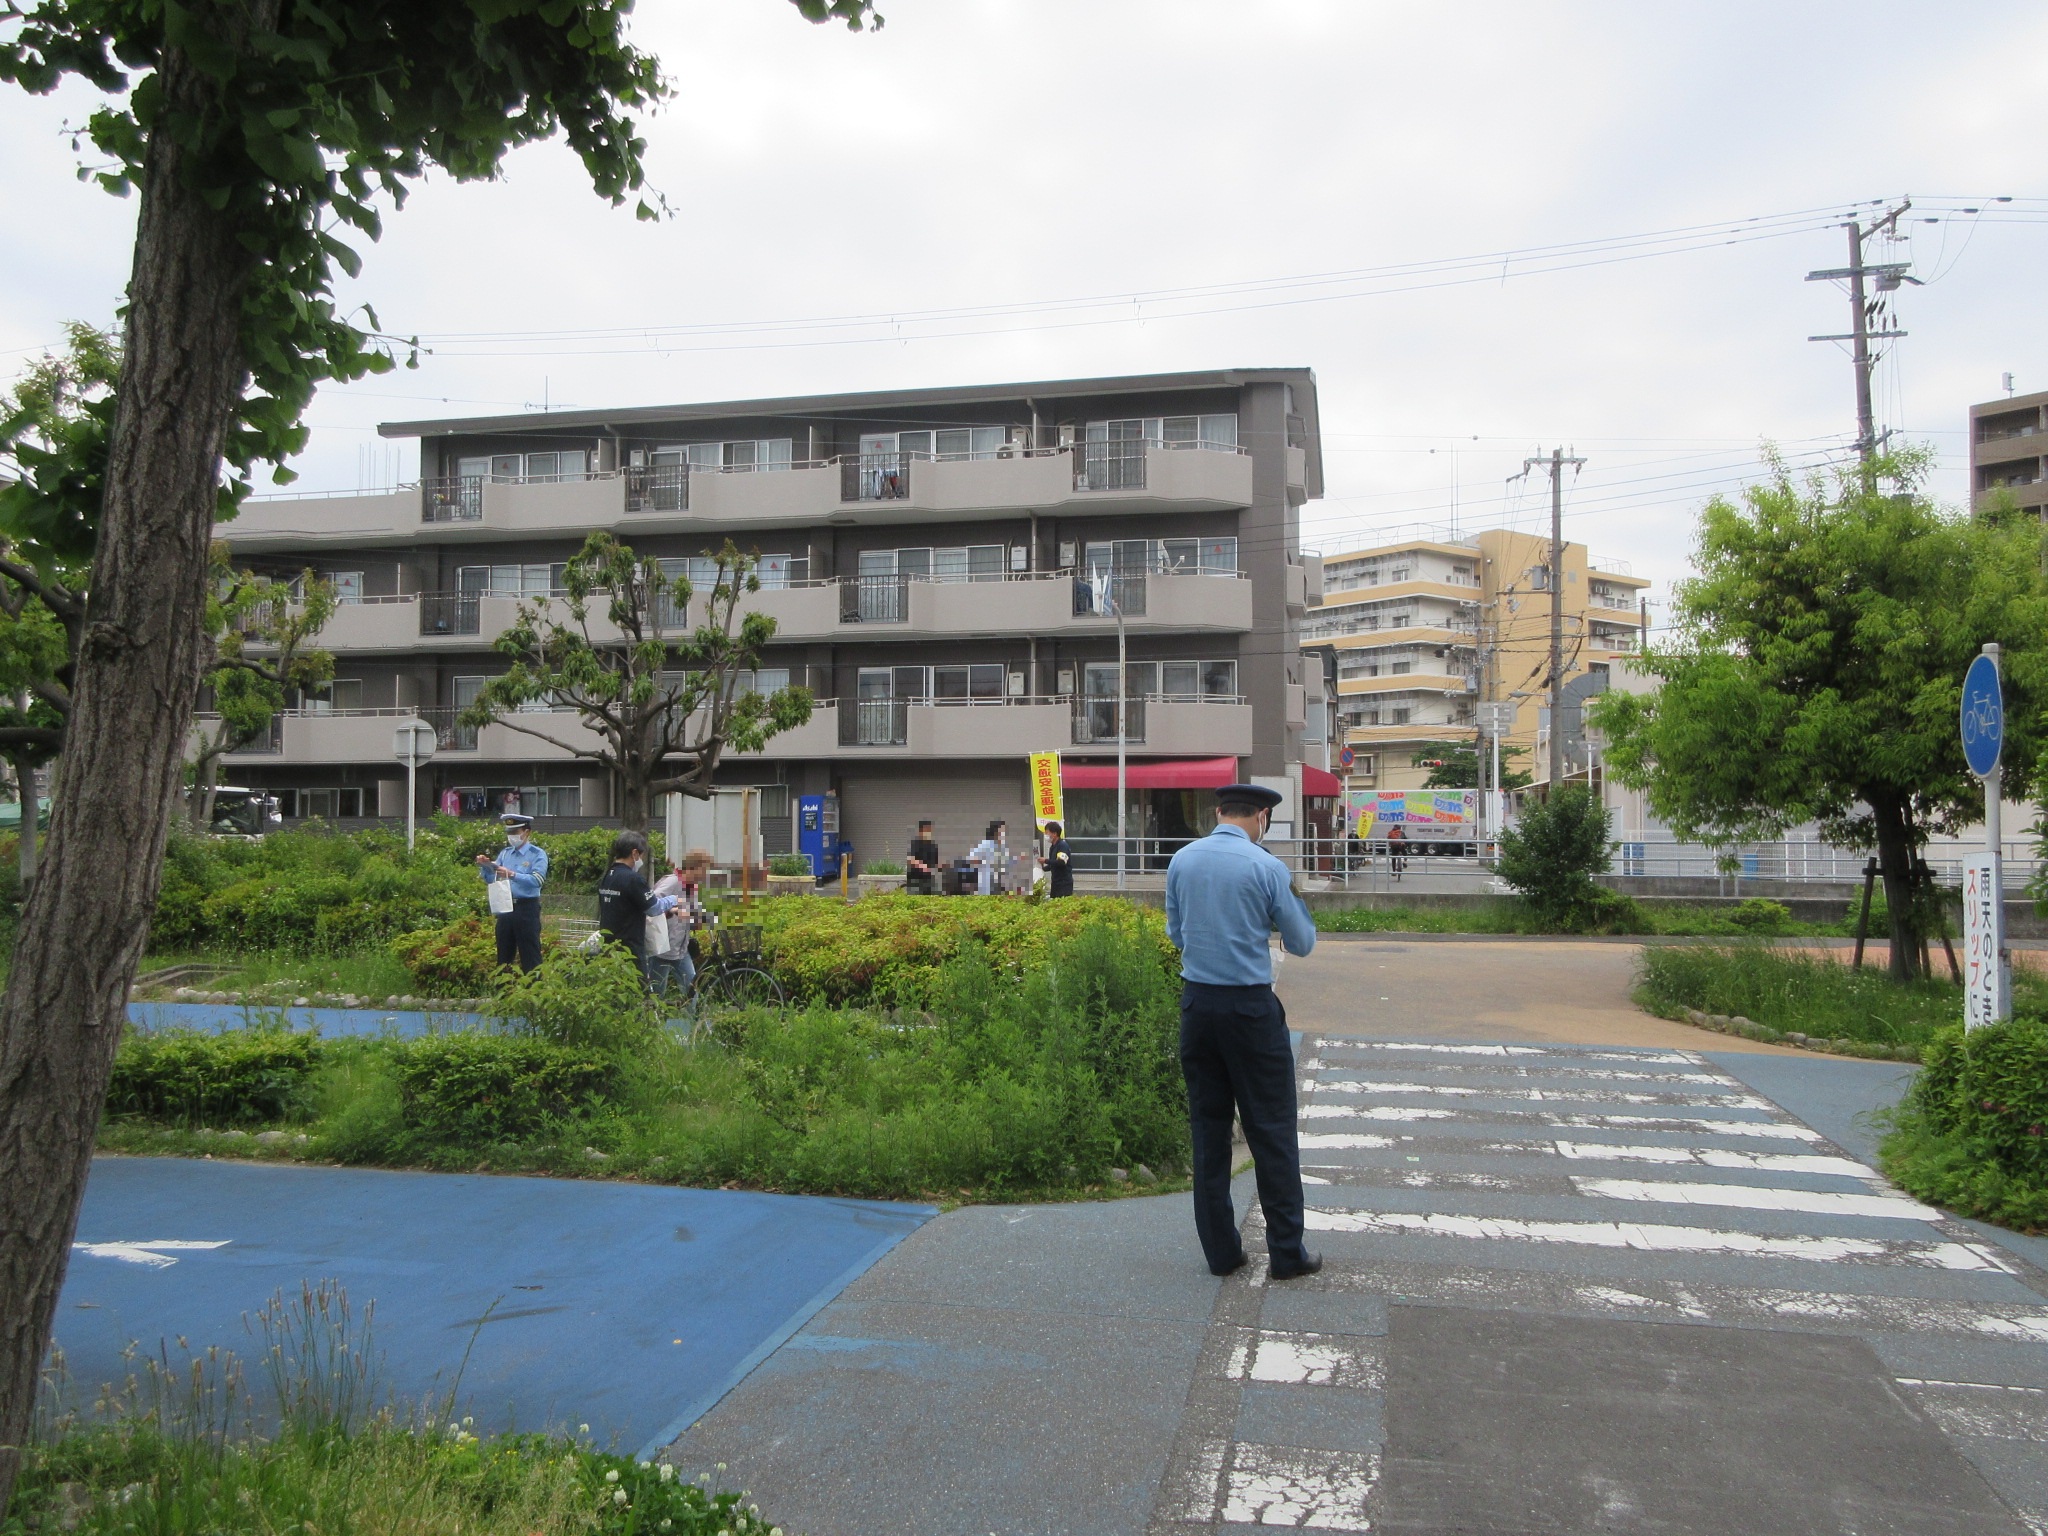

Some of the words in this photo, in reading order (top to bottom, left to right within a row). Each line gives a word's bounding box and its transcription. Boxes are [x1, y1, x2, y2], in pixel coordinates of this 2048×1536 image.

[1967, 868, 1980, 1026] スリップに
[1980, 867, 1992, 1025] 雨天のとき
